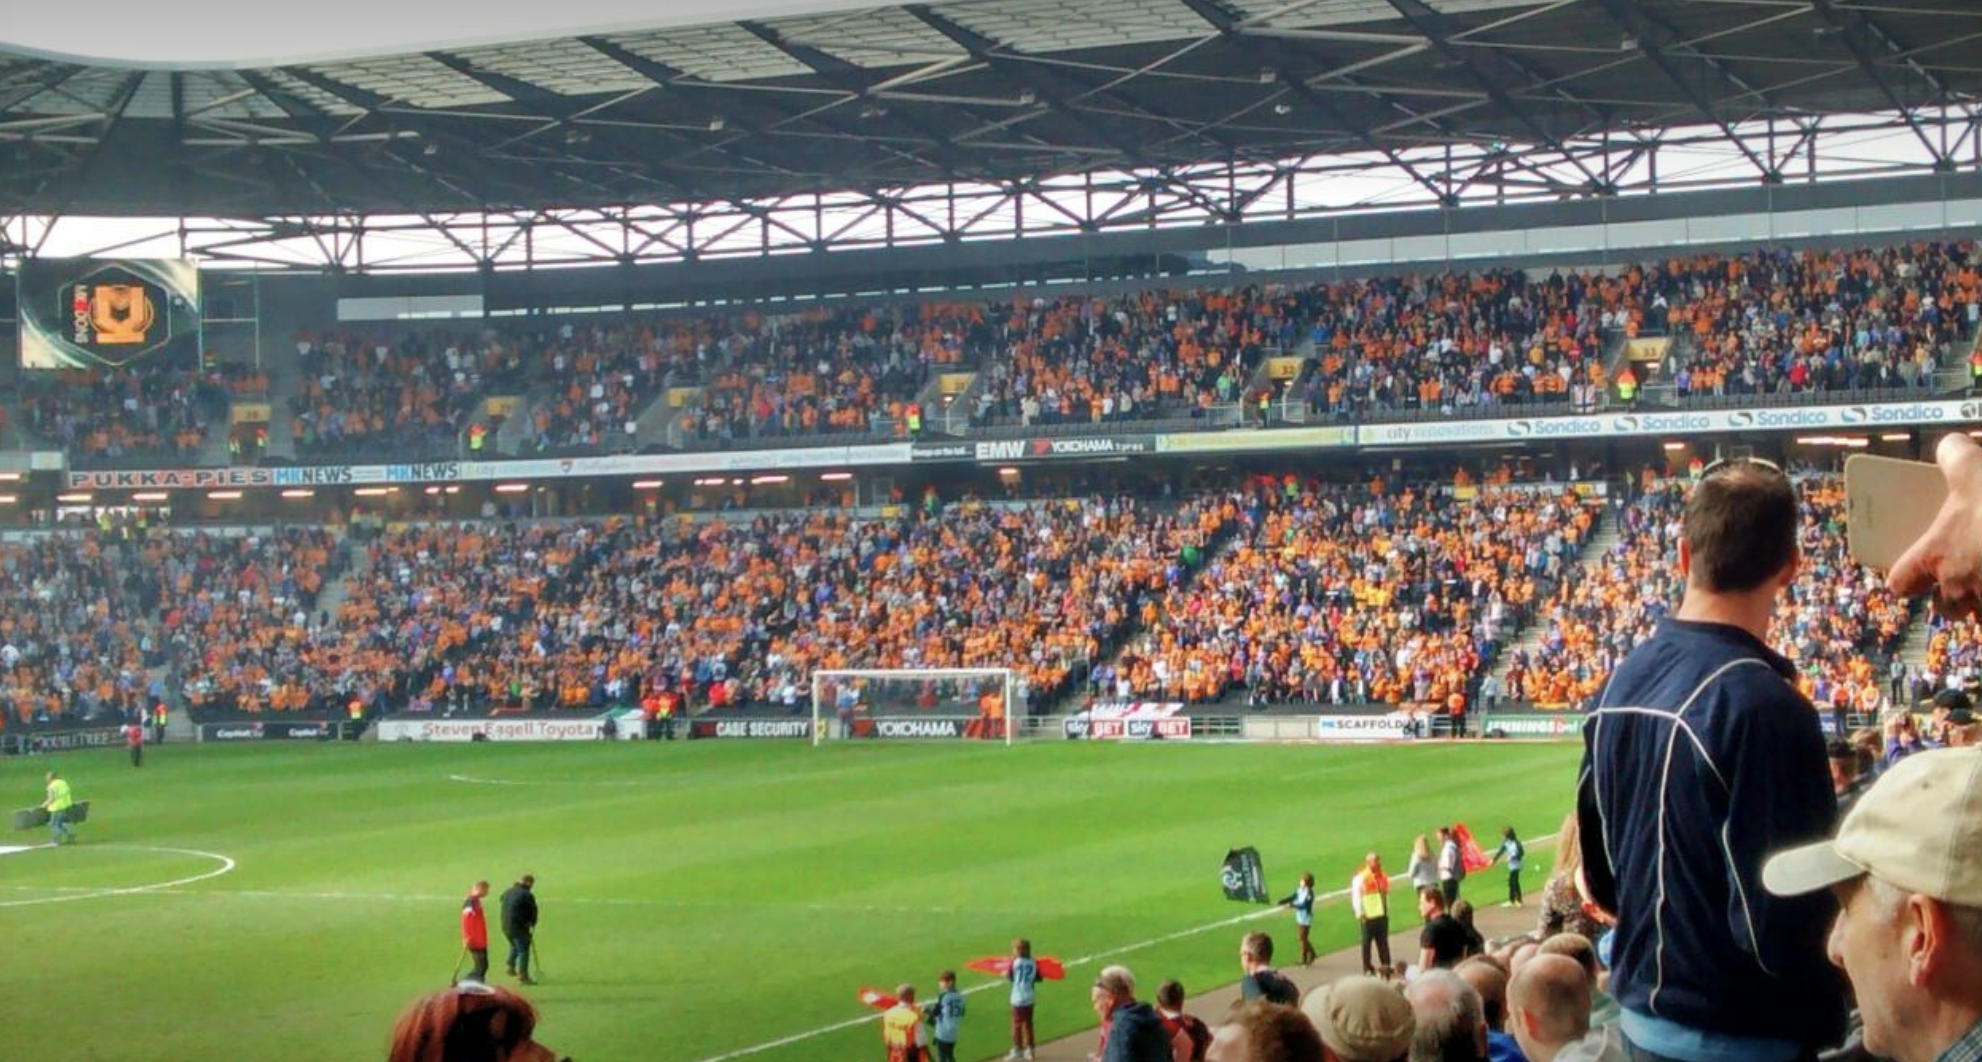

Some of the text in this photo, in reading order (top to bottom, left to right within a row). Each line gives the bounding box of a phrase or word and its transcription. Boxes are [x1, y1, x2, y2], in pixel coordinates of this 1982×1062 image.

[1758, 408, 1827, 425] Sondico
[1871, 404, 1943, 421] Sondico
[1535, 418, 1601, 434] Sondico
[1643, 413, 1710, 430] Sondico
[975, 440, 1026, 460] EMW
[1052, 439, 1113, 452] YOKOHAMA
[71, 470, 268, 487] PUKKA-PIES
[275, 466, 353, 484] MKNEWS
[386, 463, 458, 482] MKNEWS
[424, 720, 594, 738] Steven Eagell Toyota
[716, 721, 748, 737] CASE
[749, 721, 808, 737] SECURITY
[876, 720, 957, 736] YOKOHAMA
[1066, 720, 1122, 738] sky BET
[1129, 719, 1187, 738] sky BET
